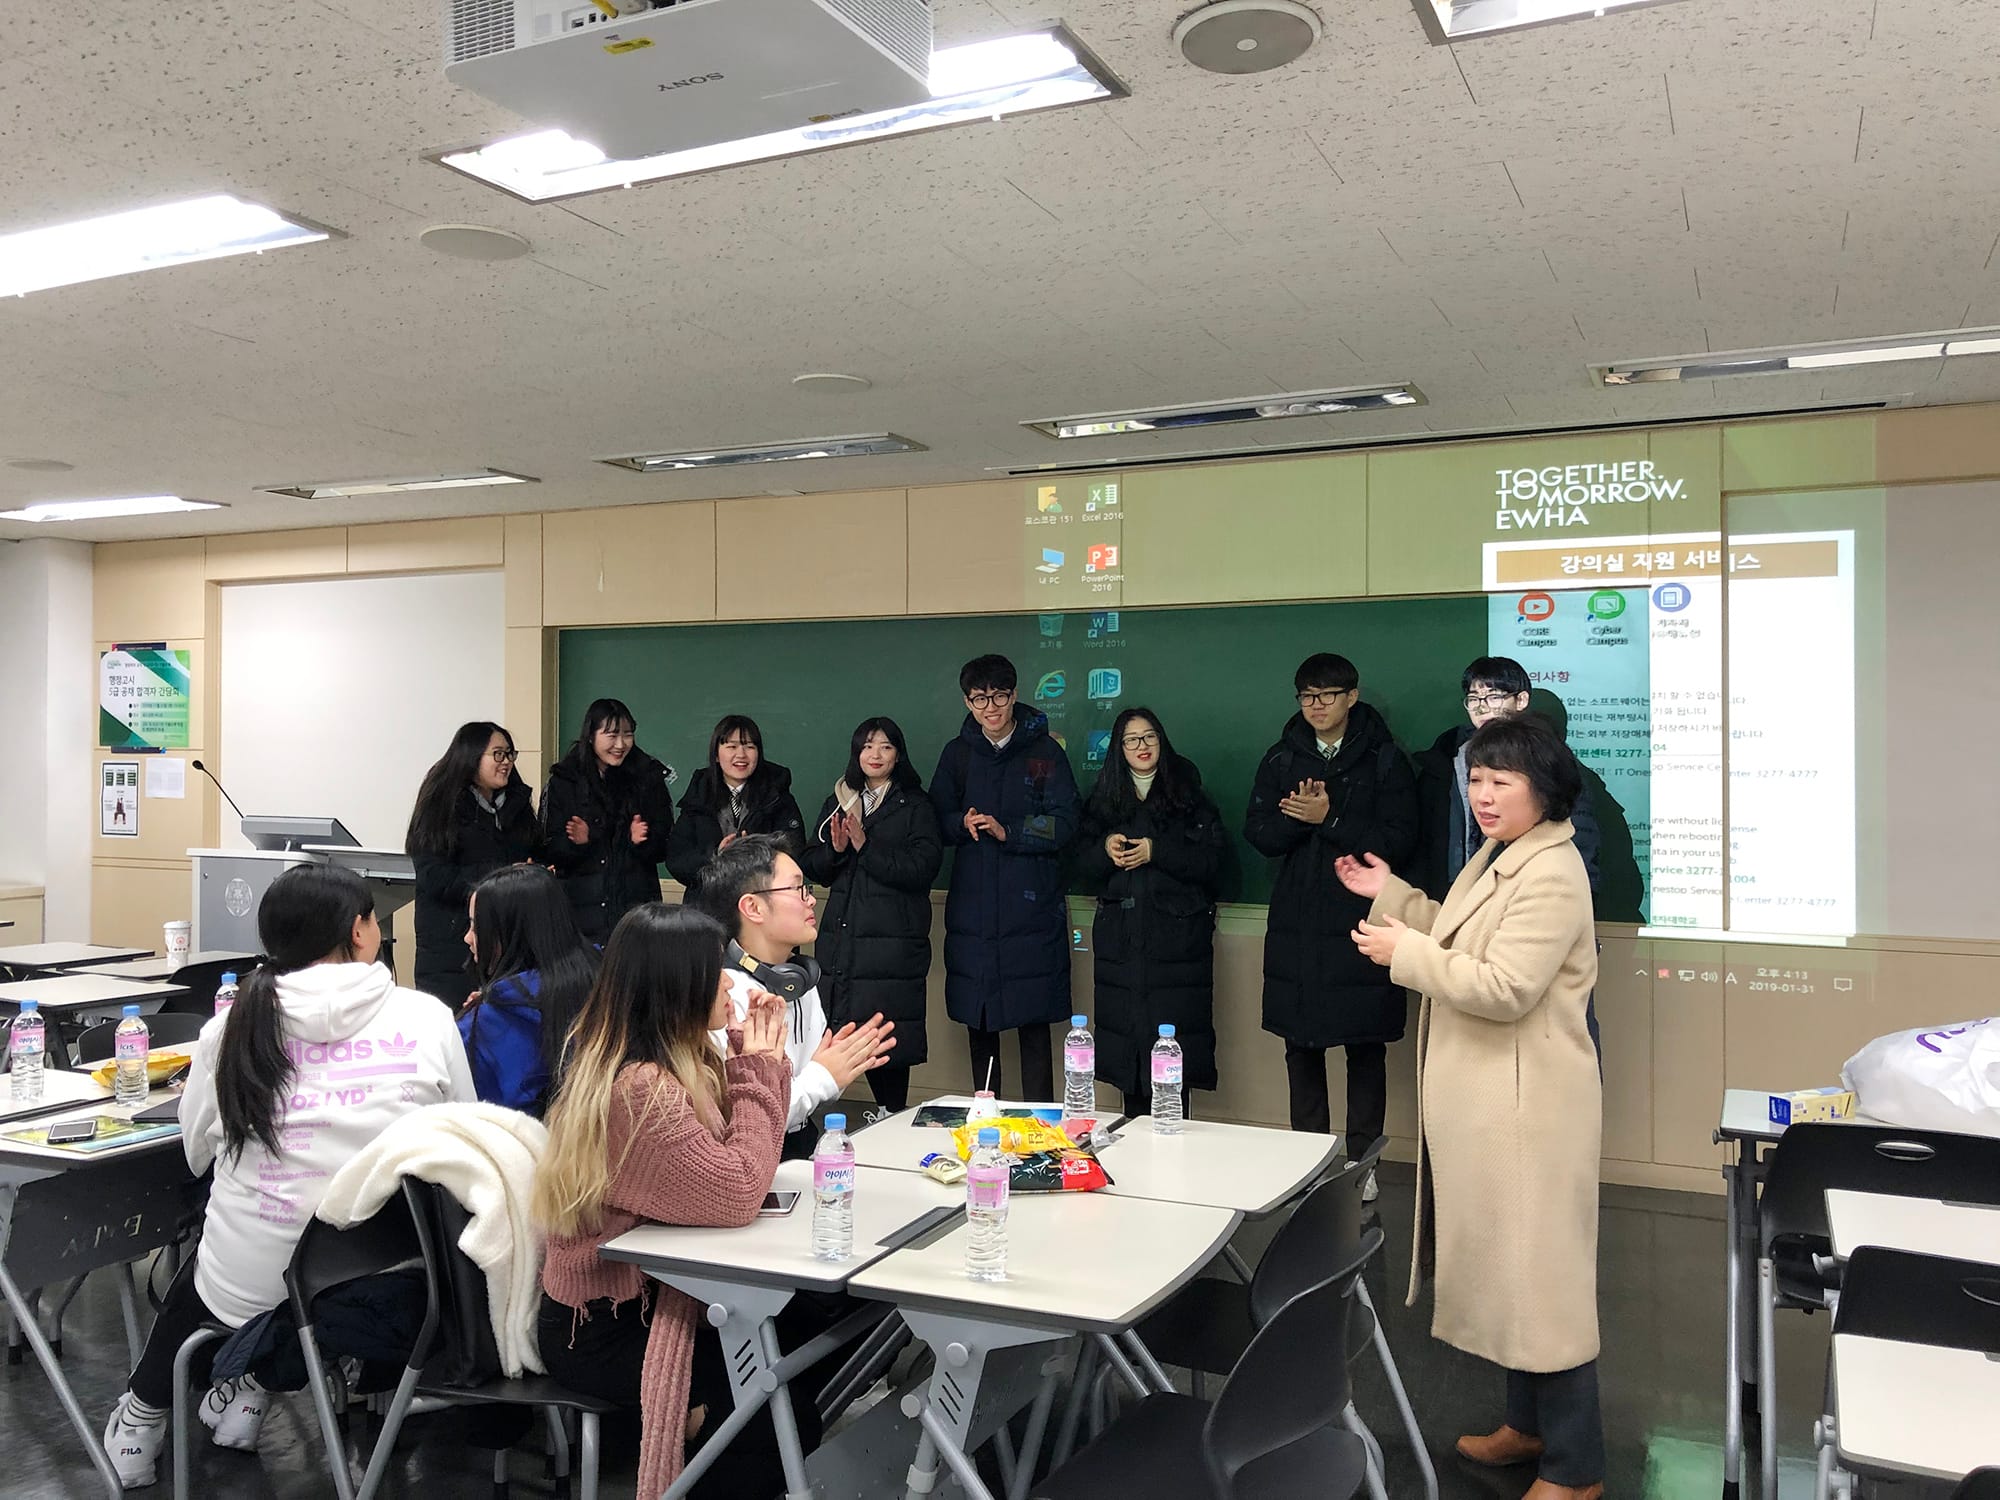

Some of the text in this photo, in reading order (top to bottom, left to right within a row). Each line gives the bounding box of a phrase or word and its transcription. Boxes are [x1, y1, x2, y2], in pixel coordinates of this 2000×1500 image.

[658, 72, 724, 92] SONY
[1495, 460, 1664, 489] TOGETHER.
[1495, 479, 1687, 510] TOMORROW.
[1081, 512, 1124, 522] Excel 2016
[1495, 507, 1589, 530] EWHA
[1560, 549, 1761, 575] 강의실 지원 서비스
[1081, 574, 1125, 584] PowerPoint
[1092, 584, 1112, 592] 2016
[1083, 639, 1126, 649] Word 2016
[108, 675, 135, 686] 행정고시
[1529, 671, 1570, 683] 의사항
[137, 687, 156, 697] 합격자
[1567, 697, 1586, 706] 없는
[1590, 697, 1650, 706] 소프트웨어는
[1668, 816, 1709, 826] without
[1669, 847, 1680, 857] in
[1682, 849, 1706, 859] your
[1749, 981, 1815, 994] 2019-01-31
[288, 1039, 373, 1065] idas
[242, 1405, 262, 1416] FILA
[120, 1446, 142, 1456] FILA
